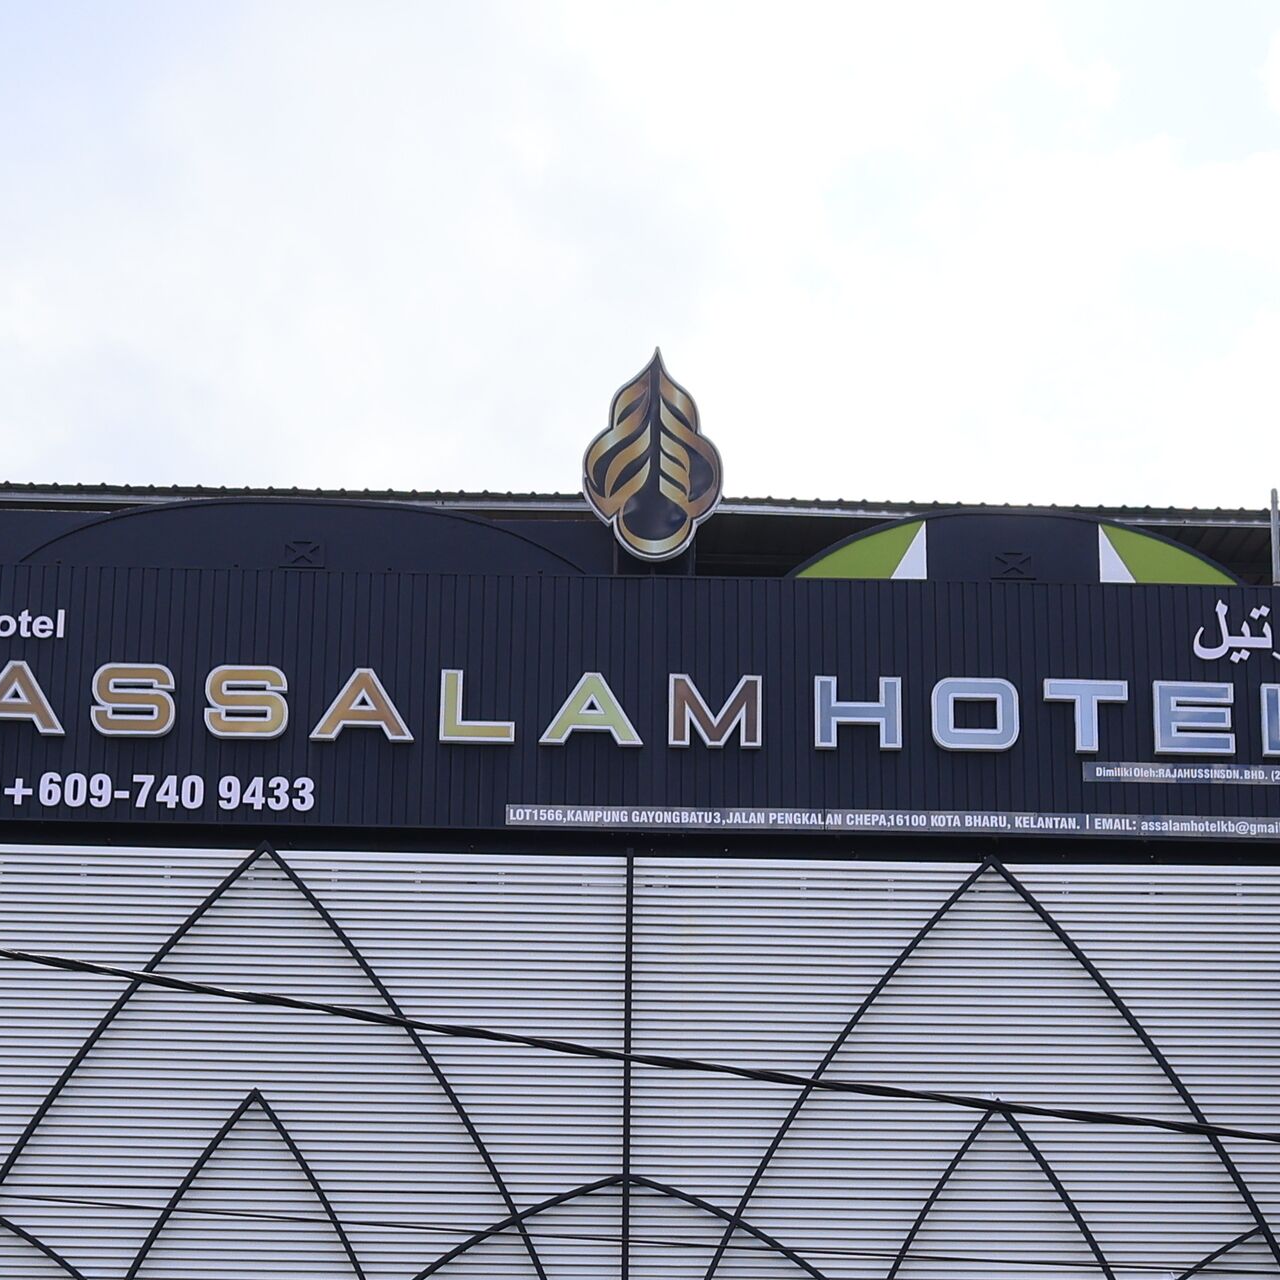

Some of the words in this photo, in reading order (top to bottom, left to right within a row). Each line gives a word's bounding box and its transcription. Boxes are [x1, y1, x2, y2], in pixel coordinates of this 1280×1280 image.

[218, 775, 316, 812] 9433
[769, 812, 842, 826] PENGKALAN
[930, 814, 961, 827] KOTA
[964, 815, 1011, 829] BHARU,
[1014, 816, 1080, 830] KELANTAN.
[1094, 817, 1137, 831] EMAIL:
